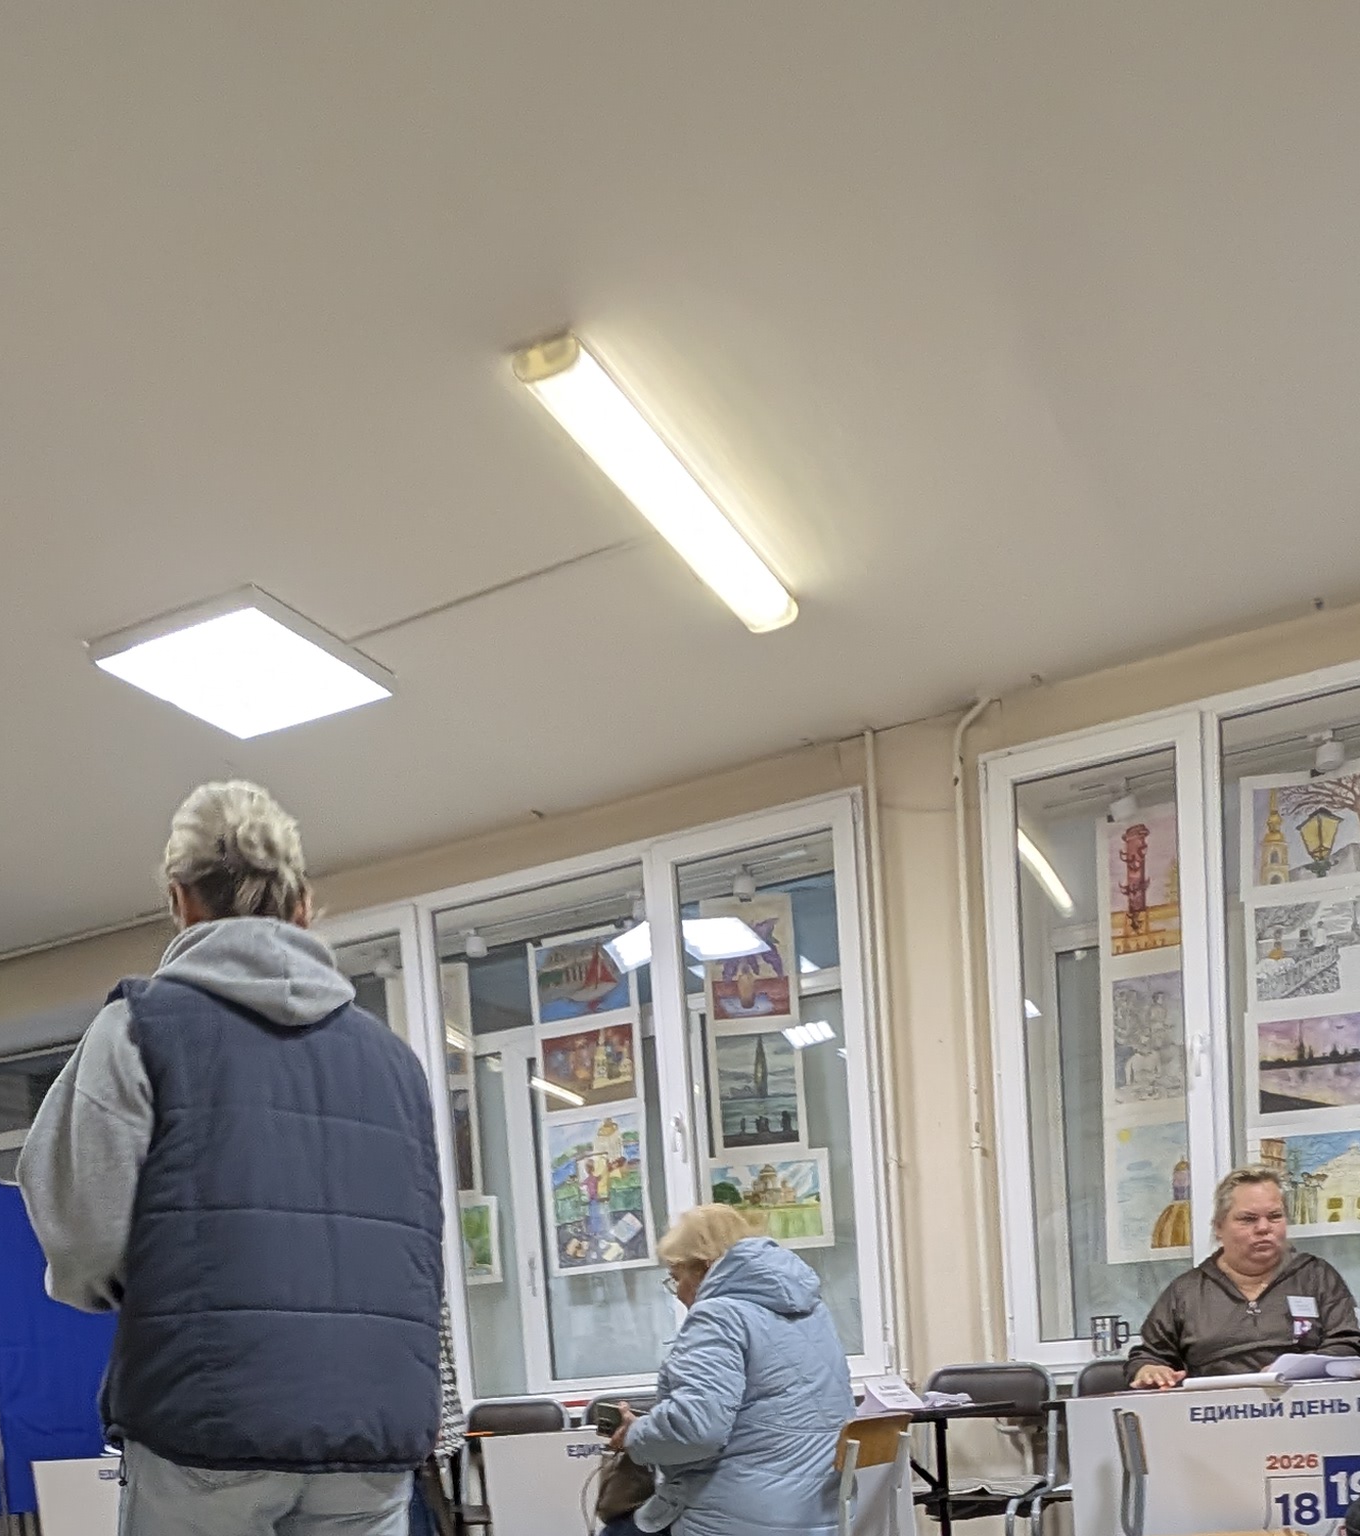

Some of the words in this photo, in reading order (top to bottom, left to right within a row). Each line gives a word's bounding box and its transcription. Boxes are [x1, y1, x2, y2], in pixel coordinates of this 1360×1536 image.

[1190, 1398, 1283, 1423] ЕДИНЫЙ
[1290, 1399, 1351, 1418] ДЕНЬ
[1266, 1454, 1318, 1470] 2026
[1274, 1493, 1320, 1525] 18
